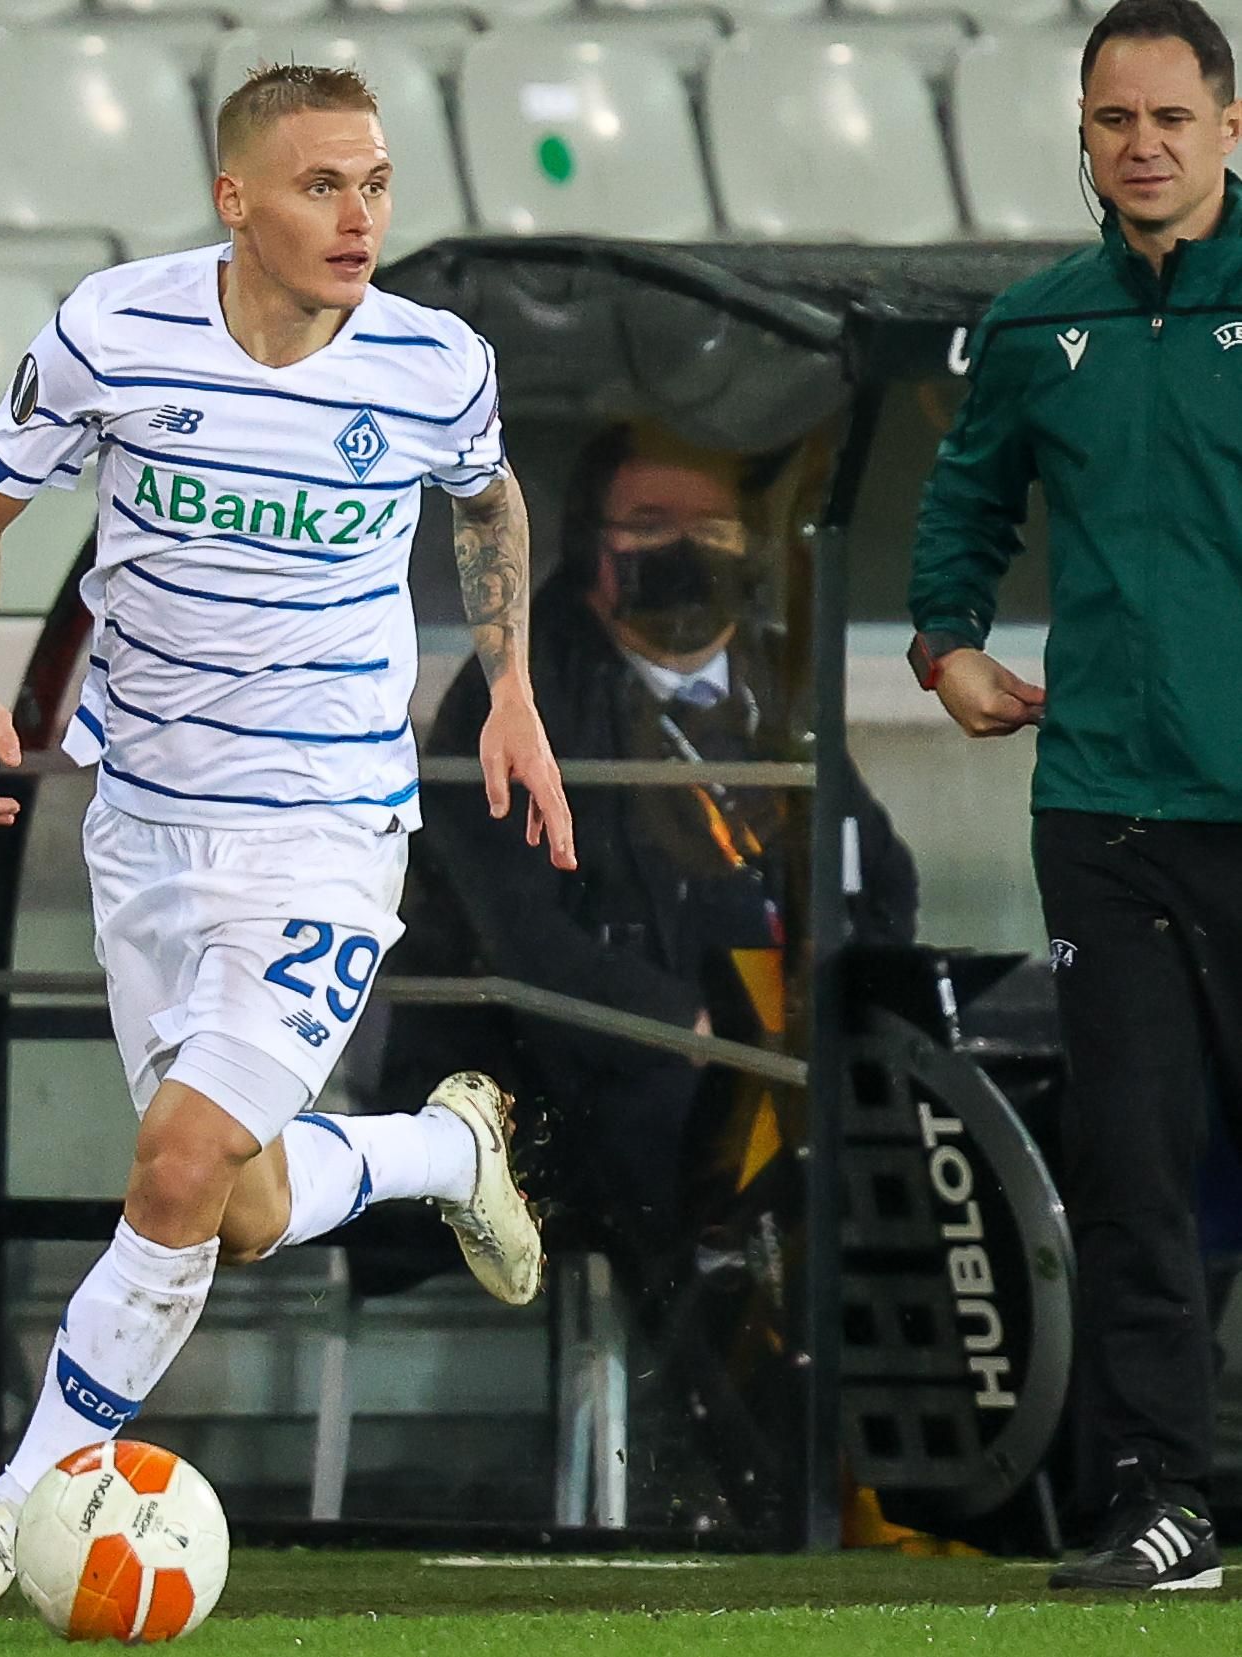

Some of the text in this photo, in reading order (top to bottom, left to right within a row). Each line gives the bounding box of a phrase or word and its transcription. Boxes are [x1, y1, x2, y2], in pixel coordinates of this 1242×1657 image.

[134, 464, 398, 544] ABank24
[263, 918, 380, 1023] 29
[918, 1101, 1017, 1410] HUBLOT
[78, 1473, 114, 1533] molten
